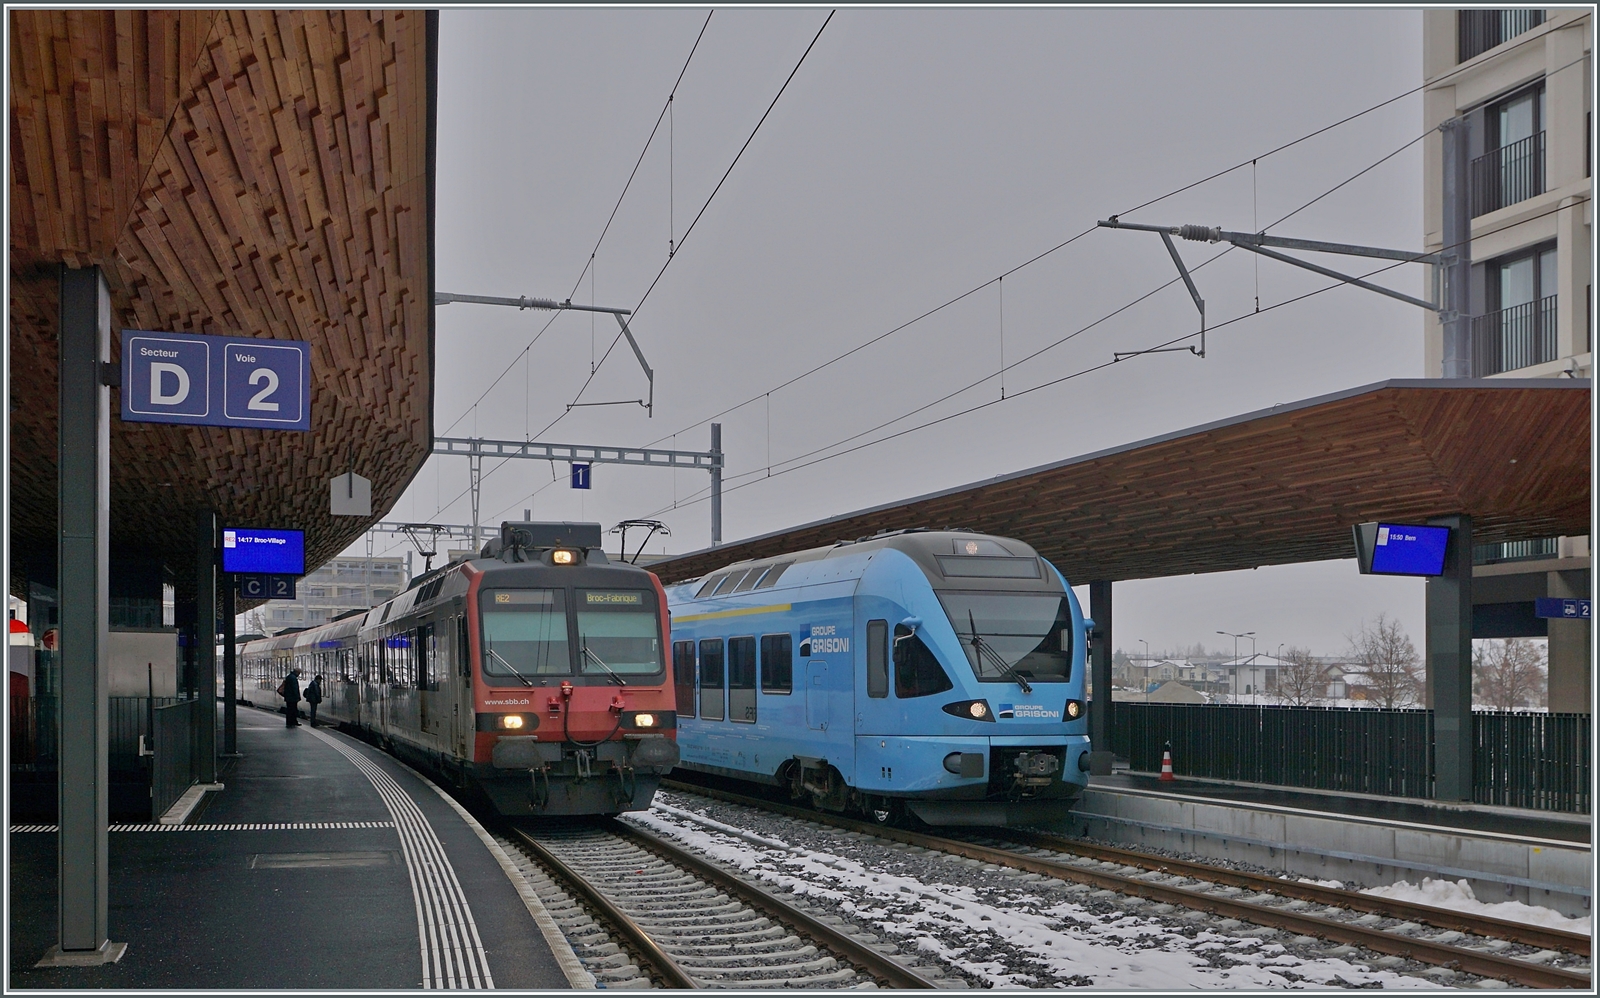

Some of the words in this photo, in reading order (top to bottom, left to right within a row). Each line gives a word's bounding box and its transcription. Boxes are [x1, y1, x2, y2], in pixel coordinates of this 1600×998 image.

[140, 347, 178, 358] Secteur
[235, 353, 257, 363] Voie
[150, 362, 190, 406] D
[247, 368, 279, 412] 2
[578, 468, 583, 485] 1
[247, 580, 260, 594] C
[277, 581, 287, 594] 2
[495, 594, 510, 603] RE2
[586, 593, 638, 604] Broc-Fabrique
[1582, 605, 1589, 615] 2
[811, 625, 836, 636] GROUPE
[811, 637, 850, 654] GRISONI
[484, 697, 530, 706] www.sbb.ch
